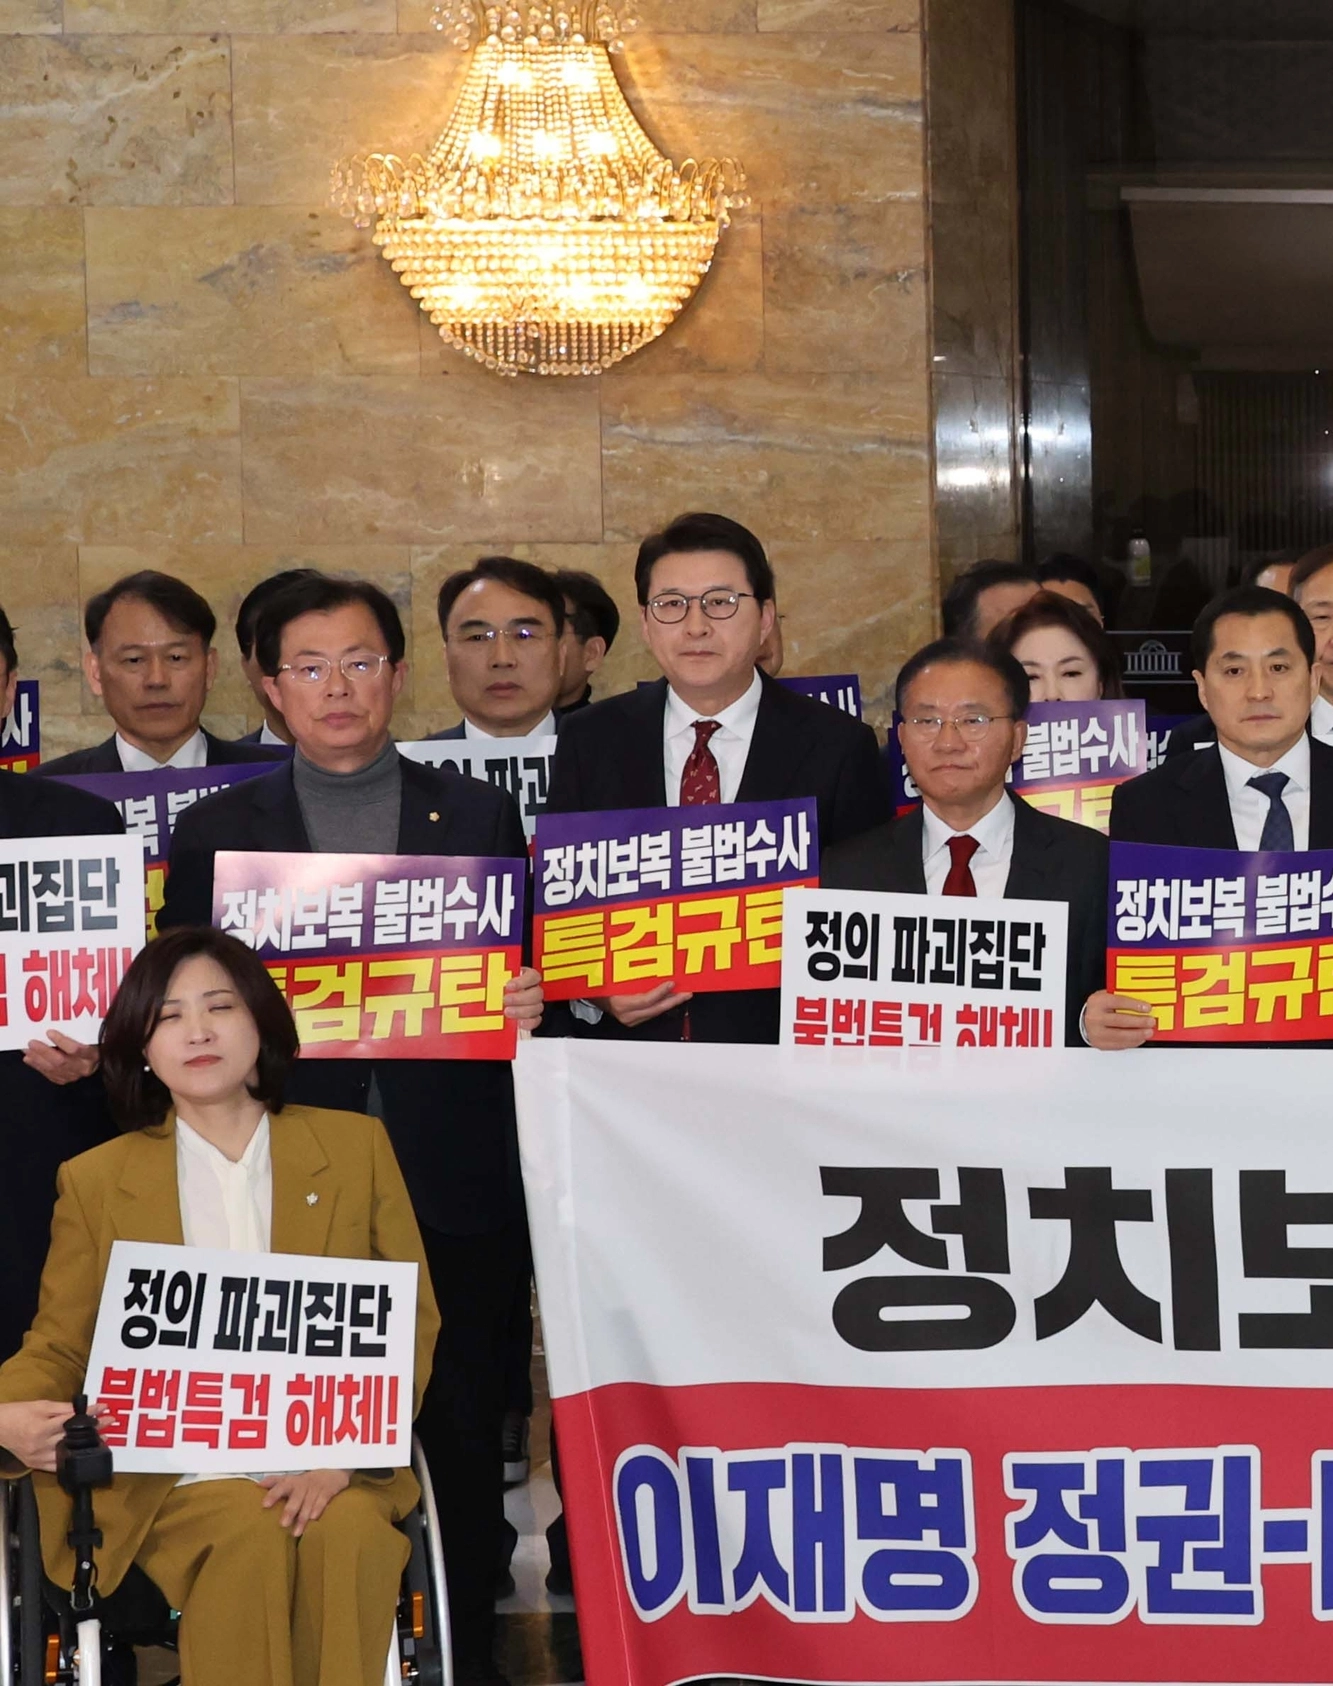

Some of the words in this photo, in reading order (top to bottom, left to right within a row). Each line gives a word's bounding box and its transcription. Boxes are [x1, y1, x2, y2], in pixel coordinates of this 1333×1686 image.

[1022, 712, 1139, 781] 불법수사
[542, 830, 672, 906] 정치보복
[681, 811, 811, 888] 불법수사
[221, 881, 364, 951] 정치보복
[373, 873, 515, 946] 불법수사
[804, 908, 882, 982] 정의
[890, 914, 1047, 992] 파괴집단
[1115, 874, 1246, 942] 정치보복
[120, 1267, 208, 1350] 정의
[213, 1276, 393, 1358] 파괴집단
[95, 1366, 271, 1450] 불법특검
[285, 1372, 400, 1447] 해체!
[613, 1444, 976, 1623] 이재명
